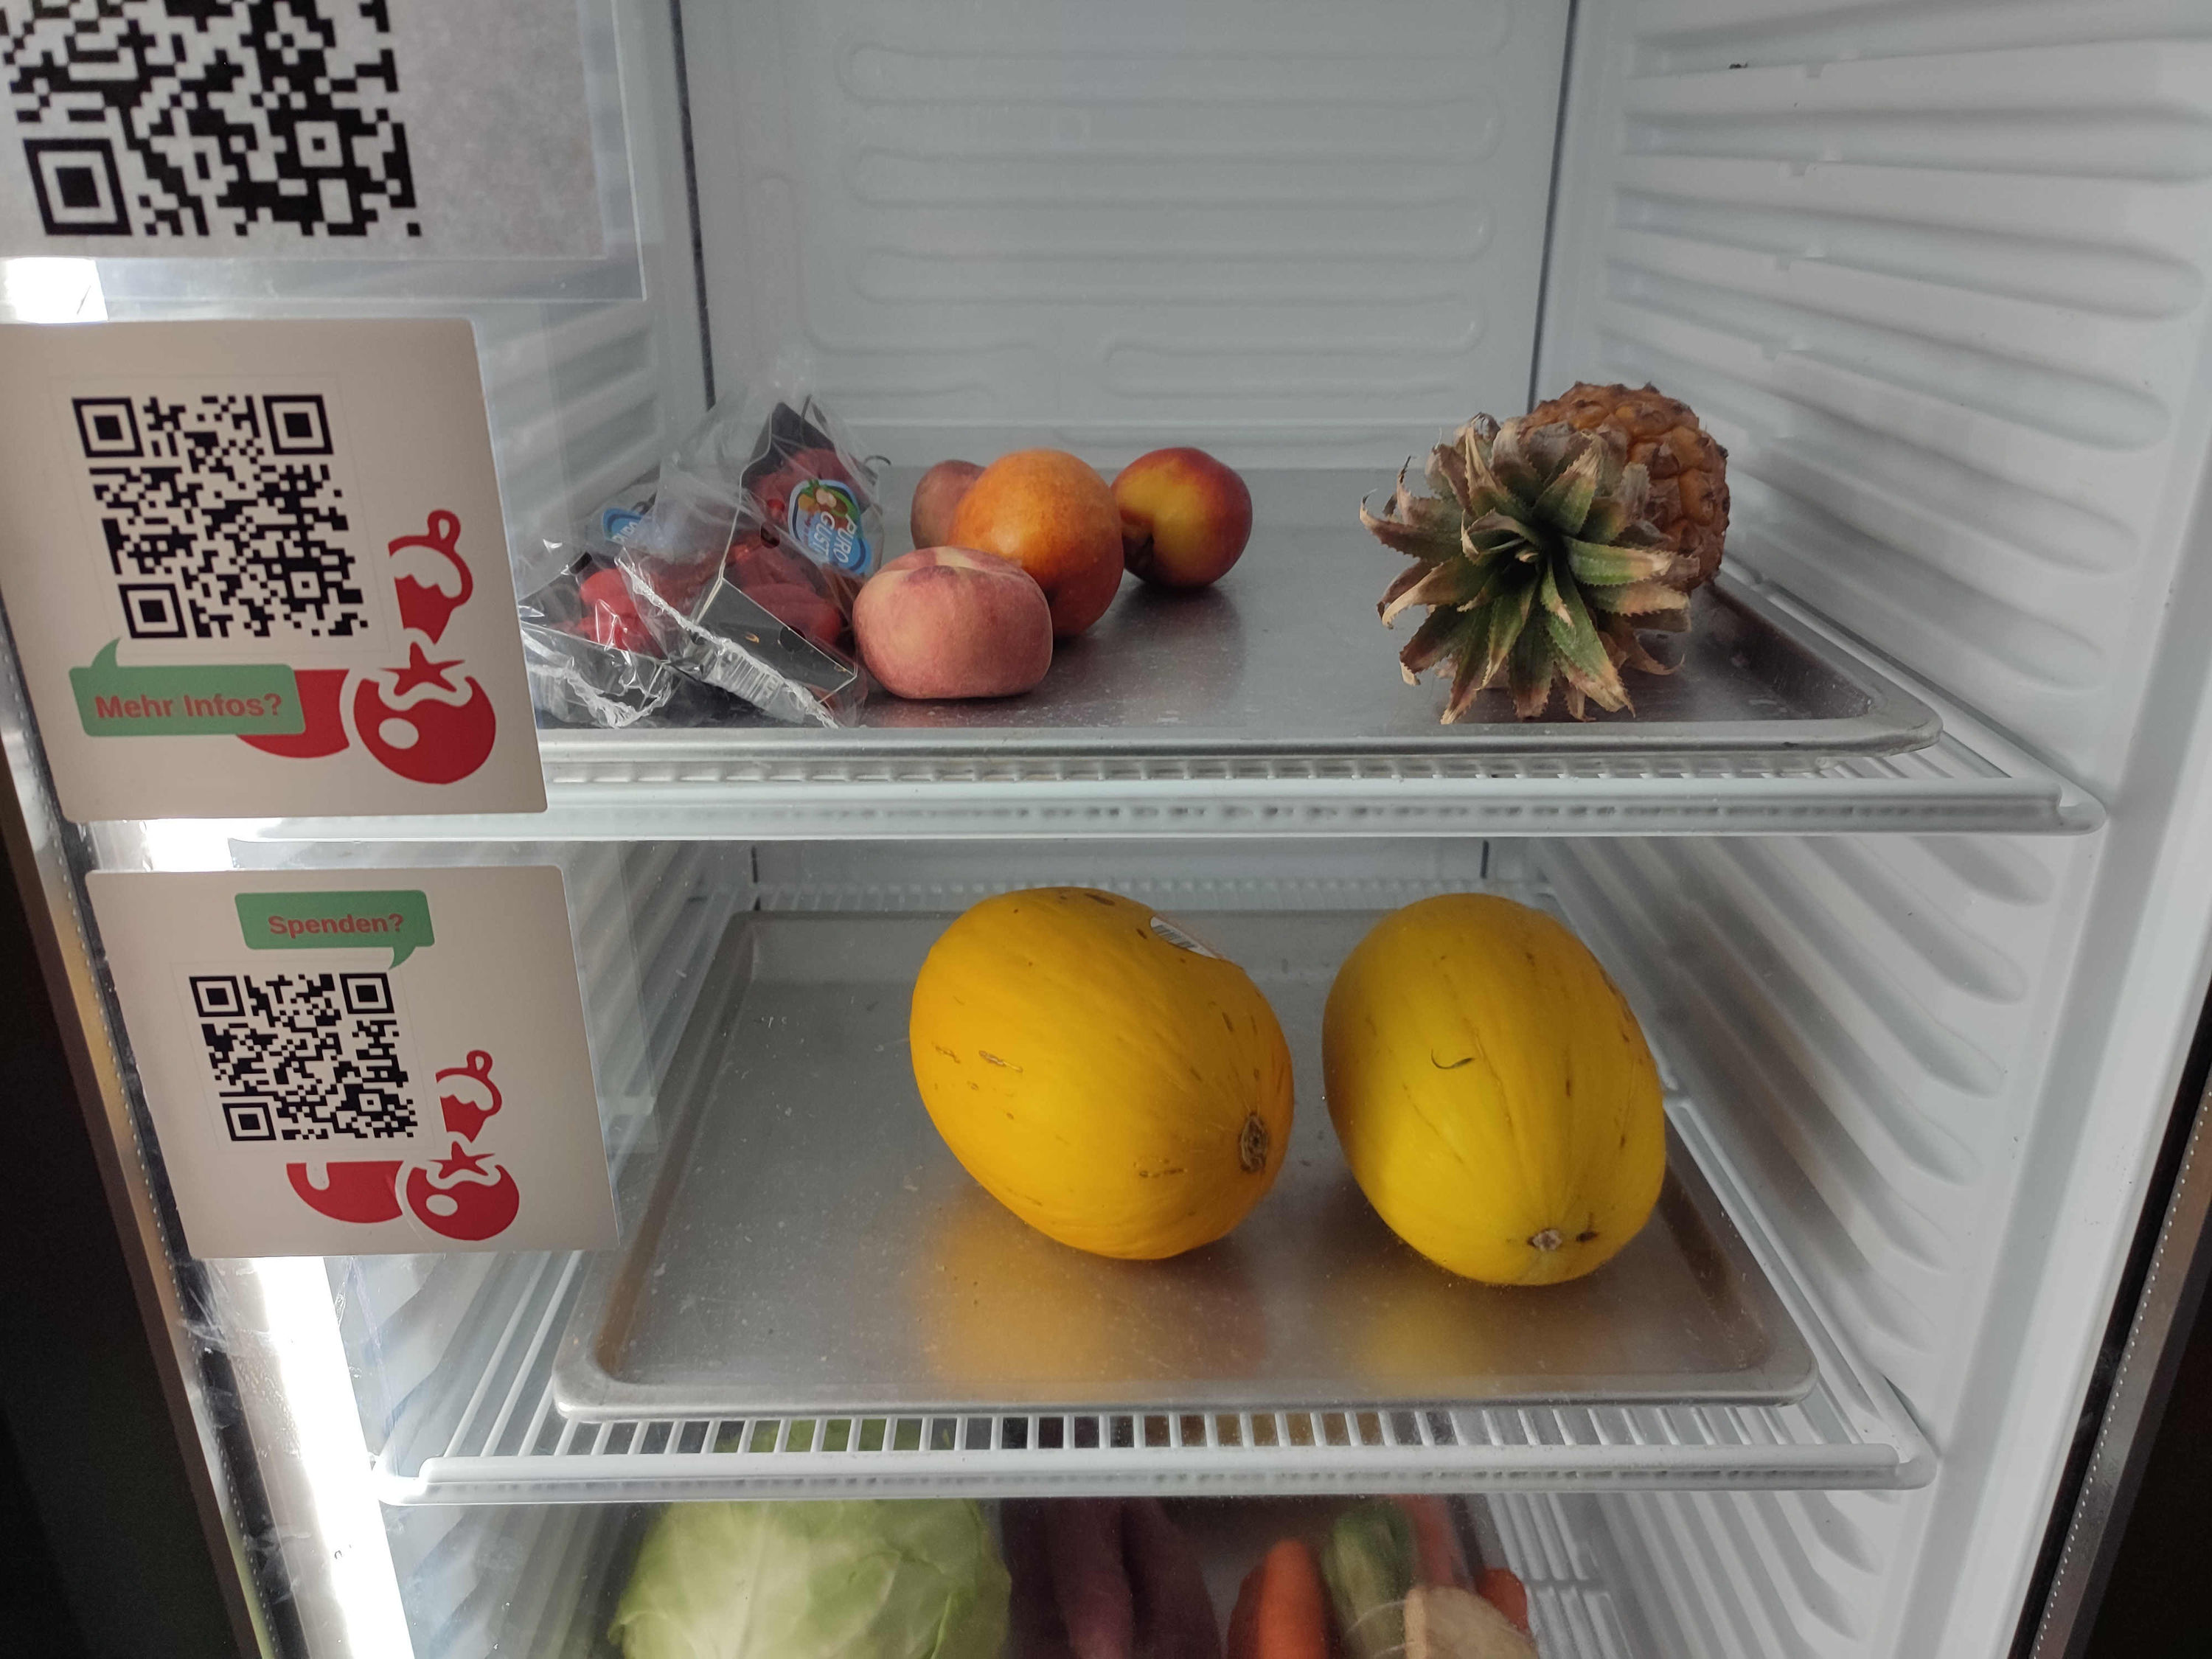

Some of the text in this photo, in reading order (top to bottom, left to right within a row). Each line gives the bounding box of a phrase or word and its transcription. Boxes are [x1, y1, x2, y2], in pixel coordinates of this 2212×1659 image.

[833, 514, 858, 563] PURO
[96, 692, 282, 719] Mehr Infos?
[268, 913, 404, 939] Spenden?
